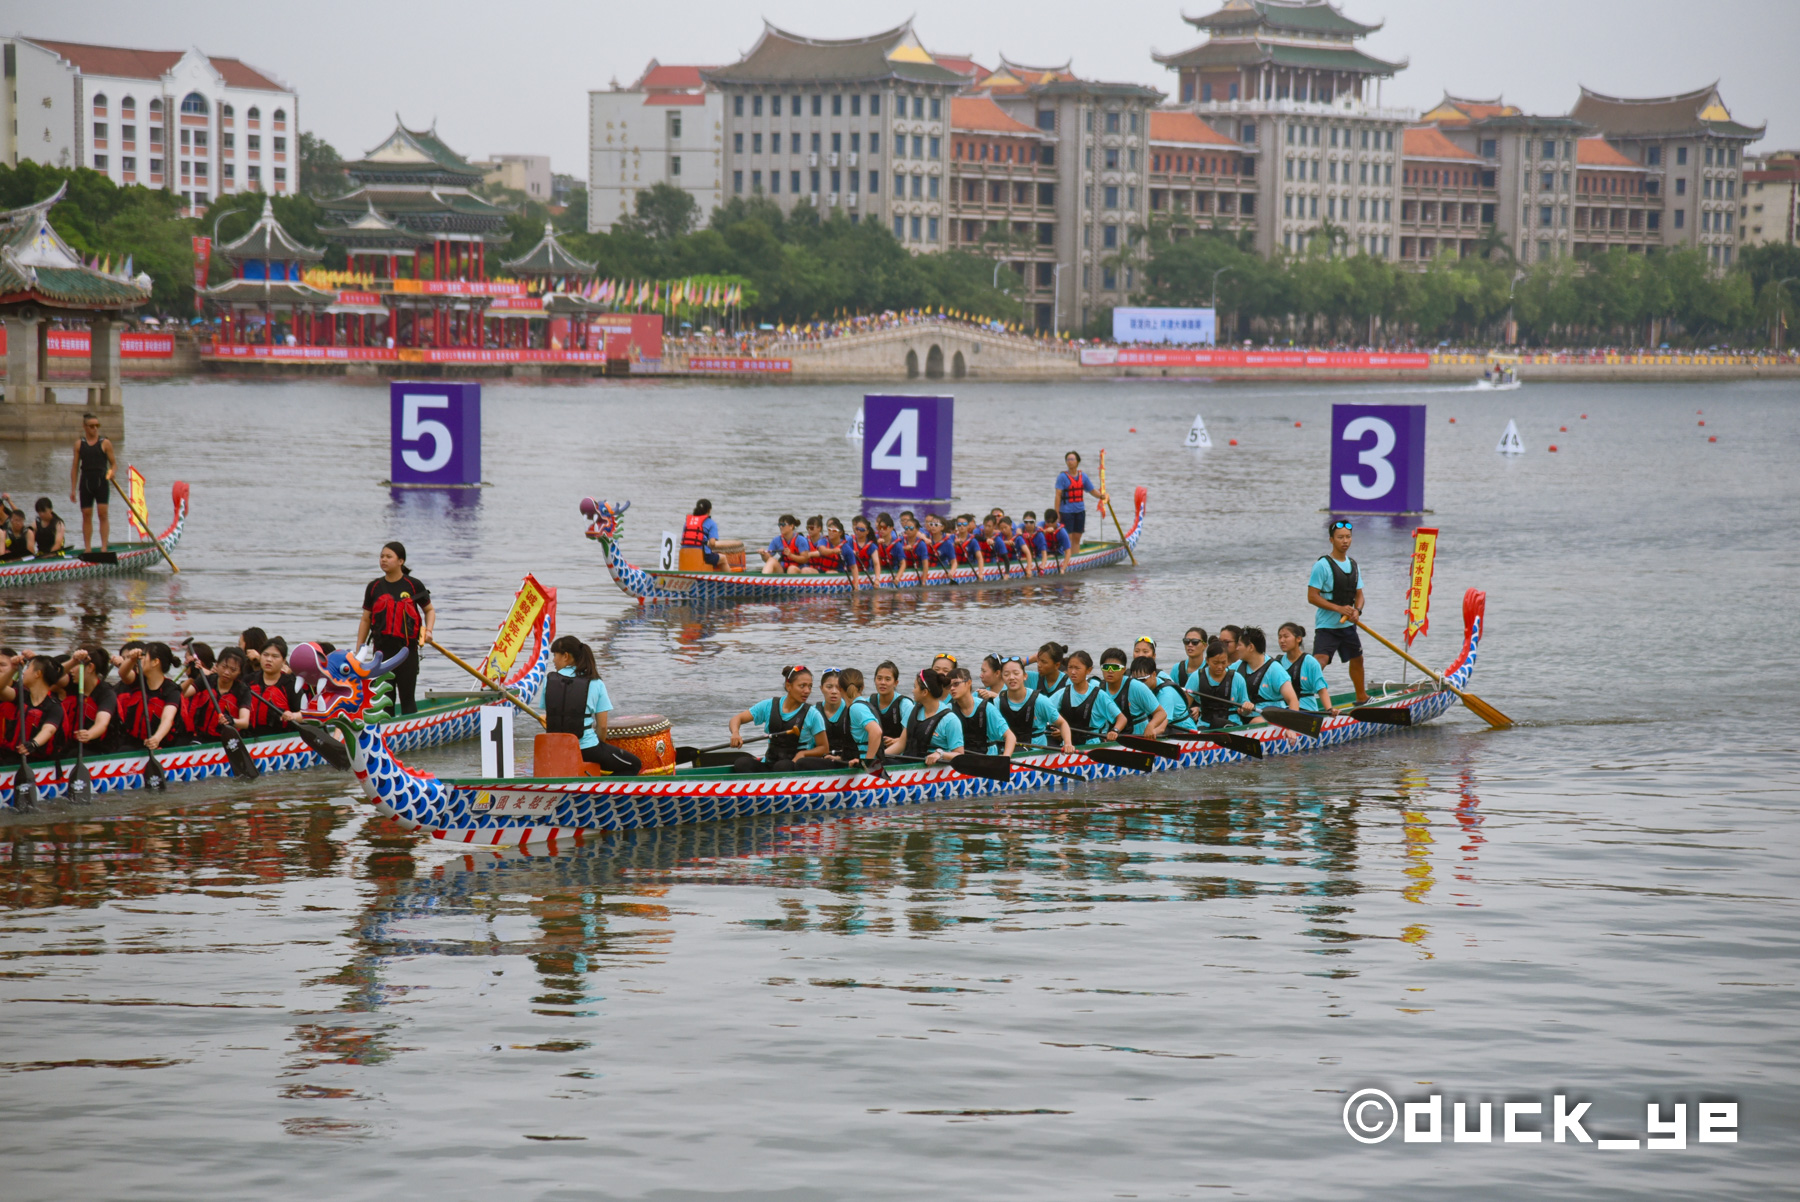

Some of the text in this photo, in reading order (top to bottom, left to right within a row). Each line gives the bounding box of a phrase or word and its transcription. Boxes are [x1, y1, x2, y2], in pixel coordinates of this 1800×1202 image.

[401, 394, 453, 473] 5
[871, 409, 927, 487] 4
[1190, 428, 1199, 443] 5
[1340, 416, 1396, 500] 3
[1501, 433, 1519, 448] 4 4
[663, 537, 673, 571] 3
[490, 716, 504, 778] 1
